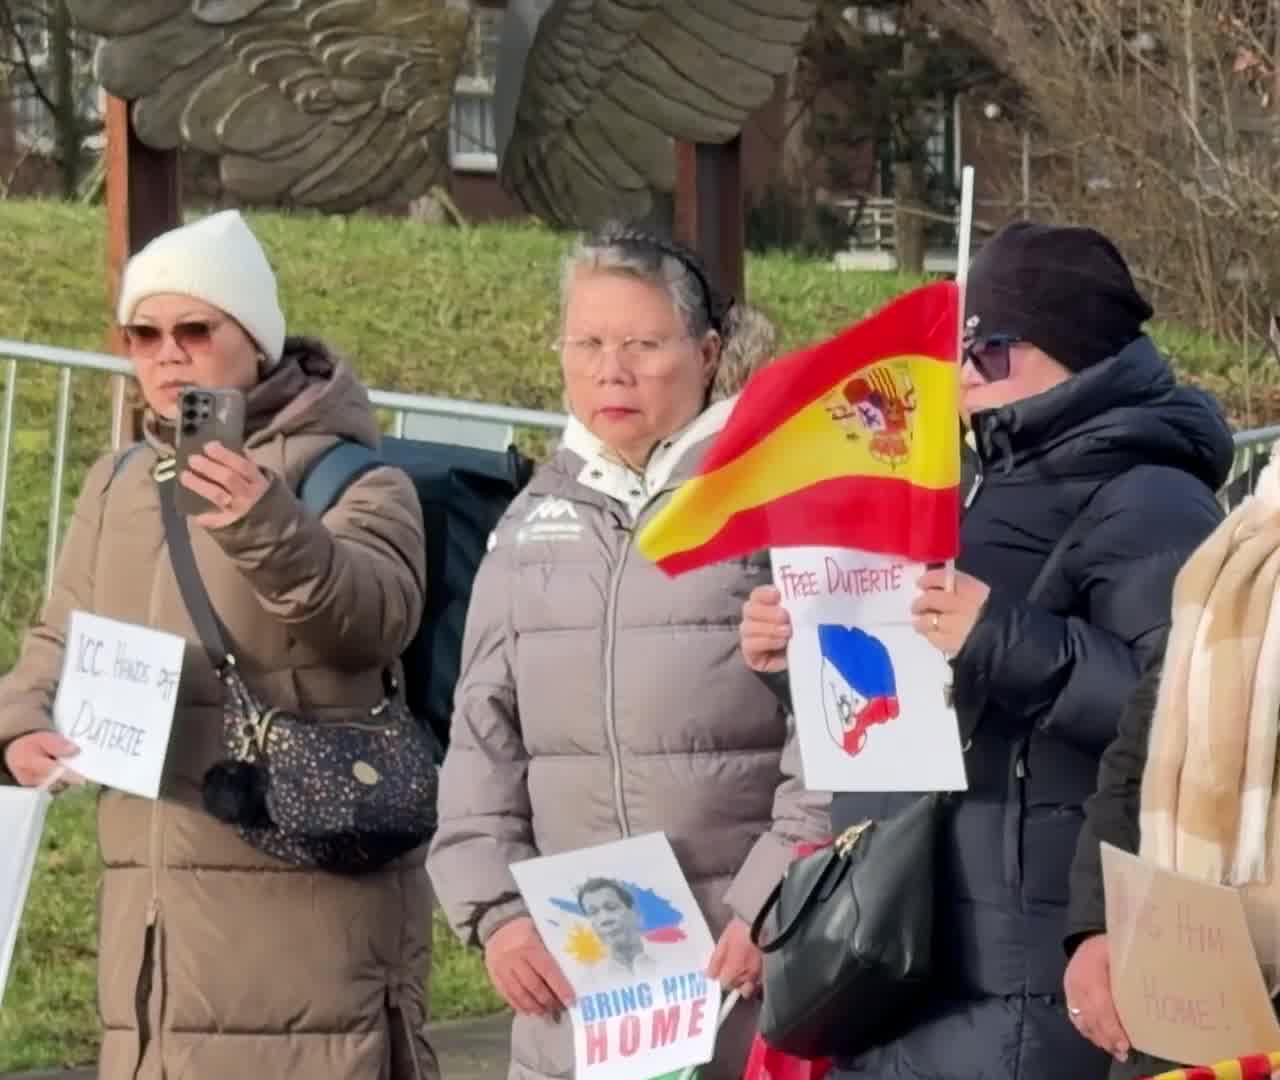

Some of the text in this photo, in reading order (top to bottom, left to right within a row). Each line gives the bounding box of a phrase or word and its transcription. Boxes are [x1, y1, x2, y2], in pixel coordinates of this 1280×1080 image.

[779, 556, 905, 601] FREE DUTERTE
[79, 632, 104, 677] ICC
[68, 698, 147, 757] DUTERTE
[580, 972, 707, 1022] BRING HIM
[584, 998, 706, 1066] HOME
